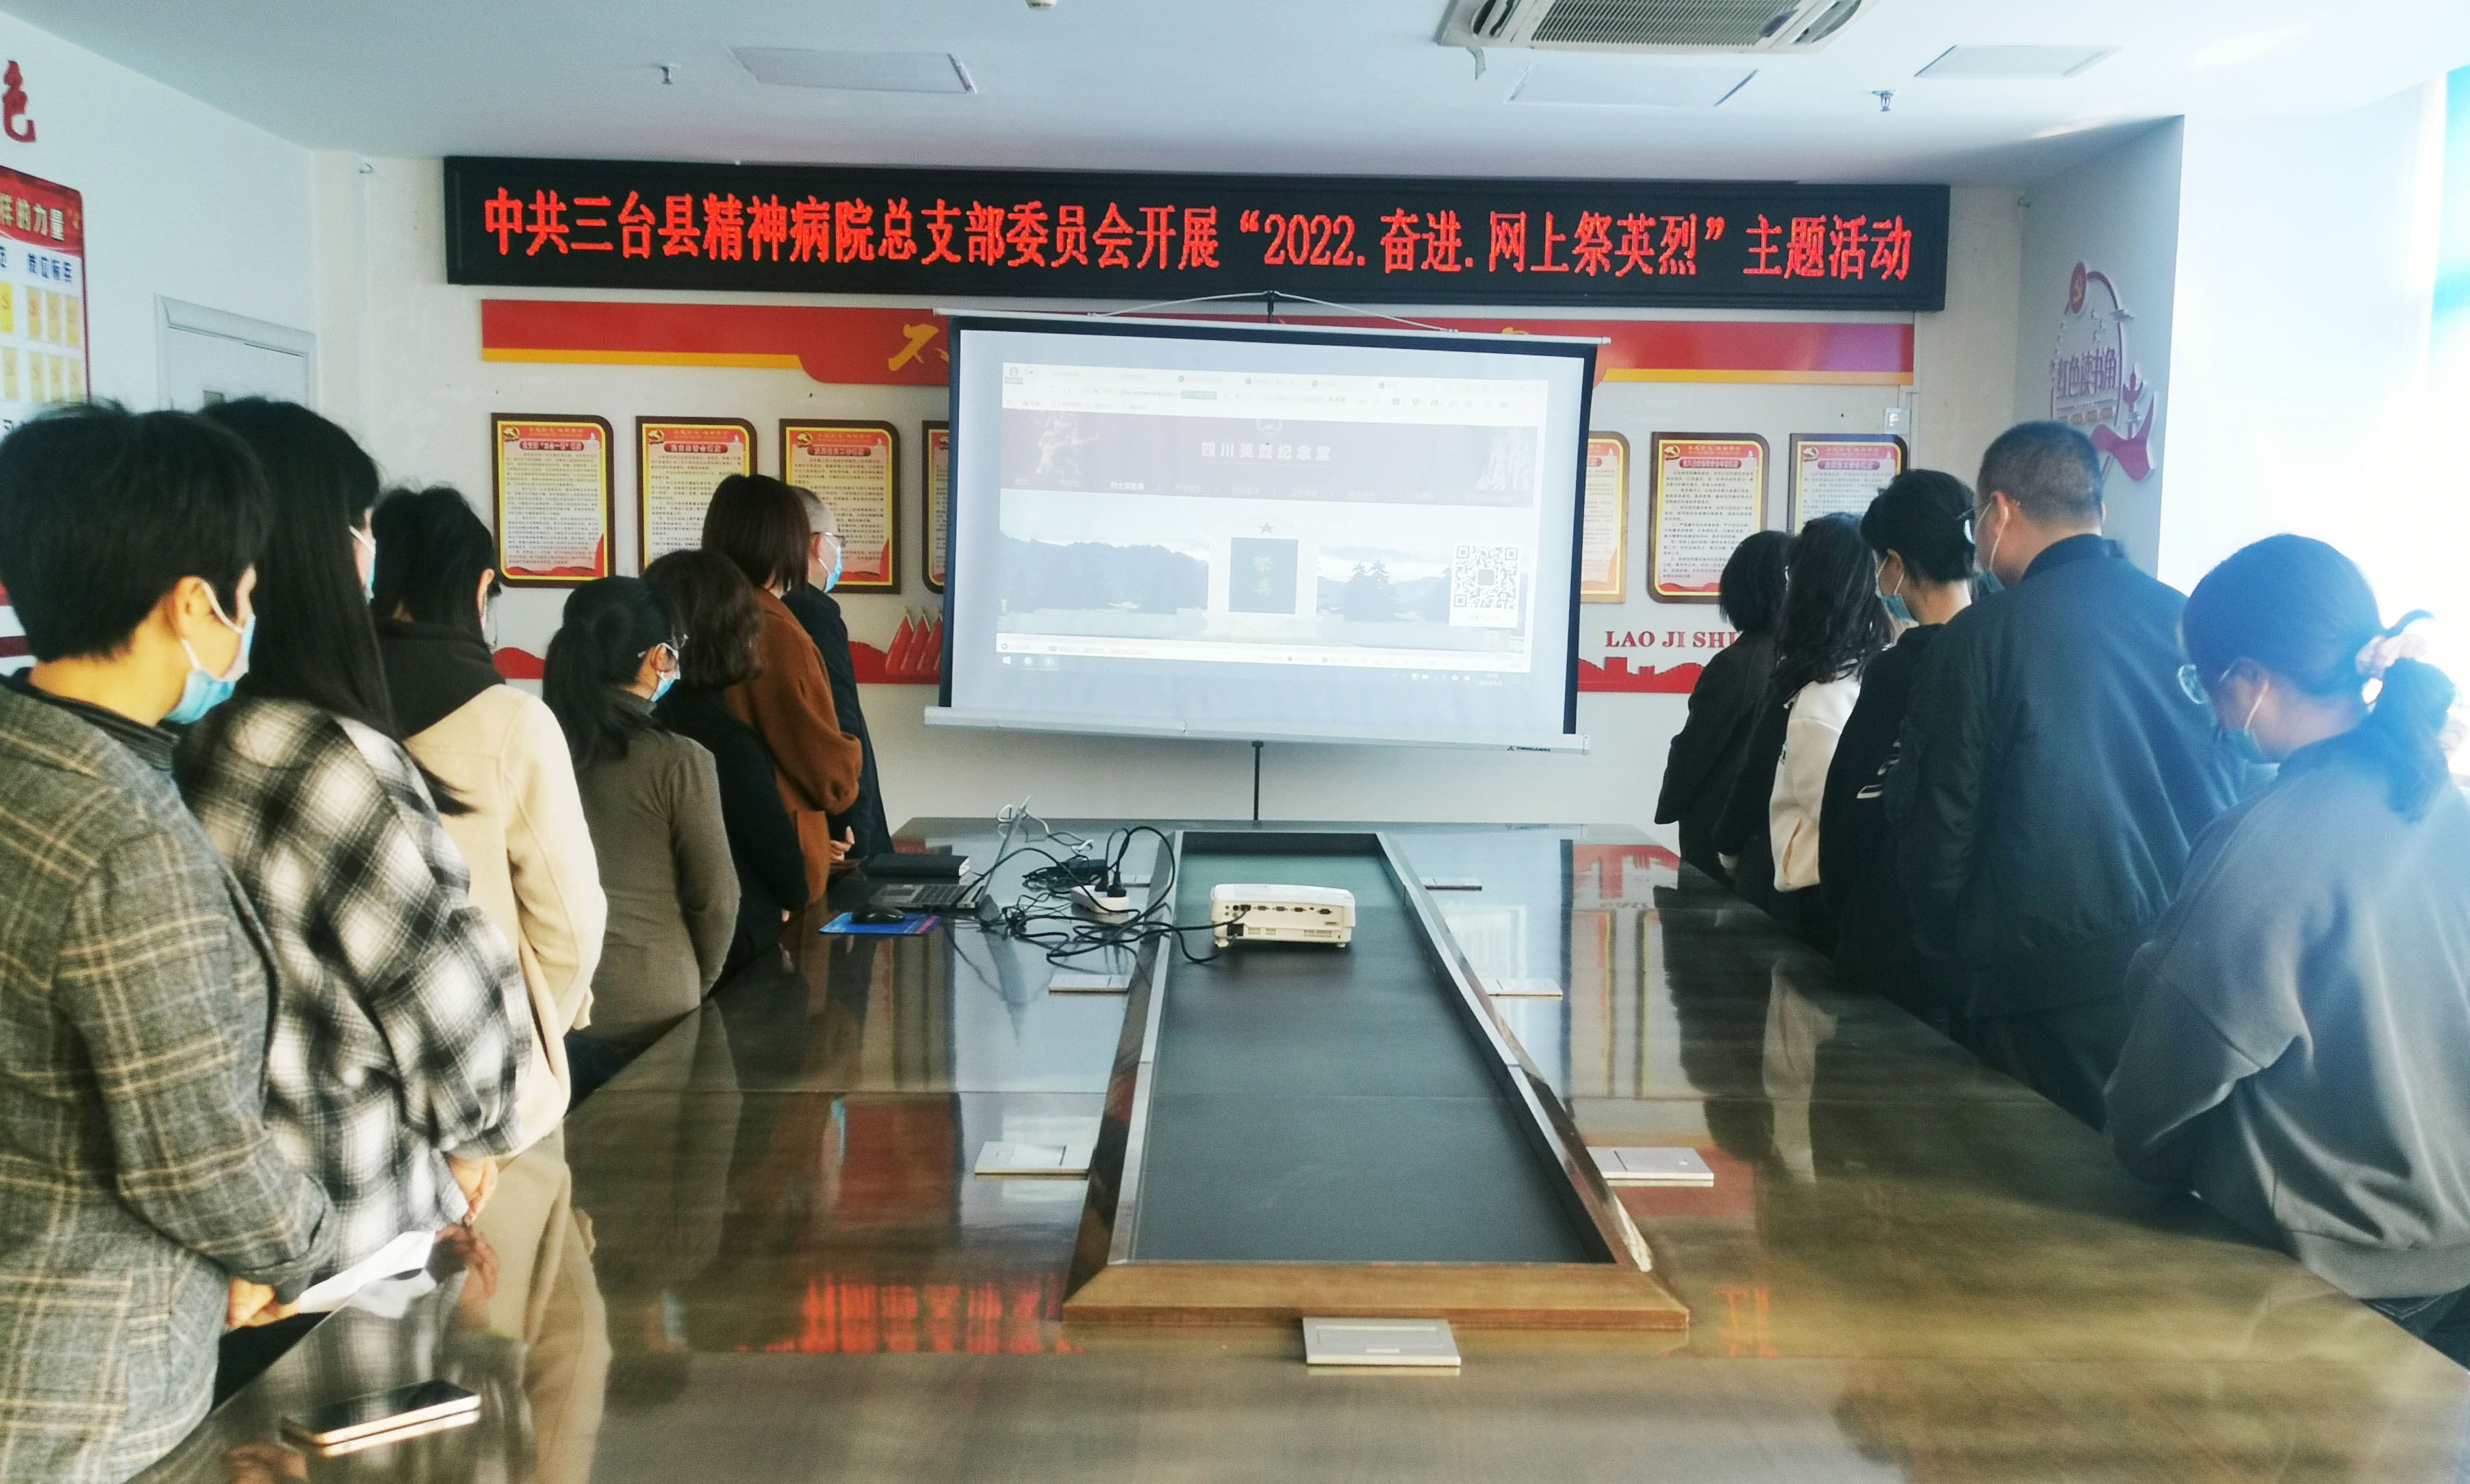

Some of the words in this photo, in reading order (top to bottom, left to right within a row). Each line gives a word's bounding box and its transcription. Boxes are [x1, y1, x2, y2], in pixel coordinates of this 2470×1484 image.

[2056, 345, 2117, 400] 红色读书角
[1200, 441, 1332, 461] 四川英烈纪念堂
[1605, 630, 1656, 648] LAO
[1662, 631, 1685, 648] JI
